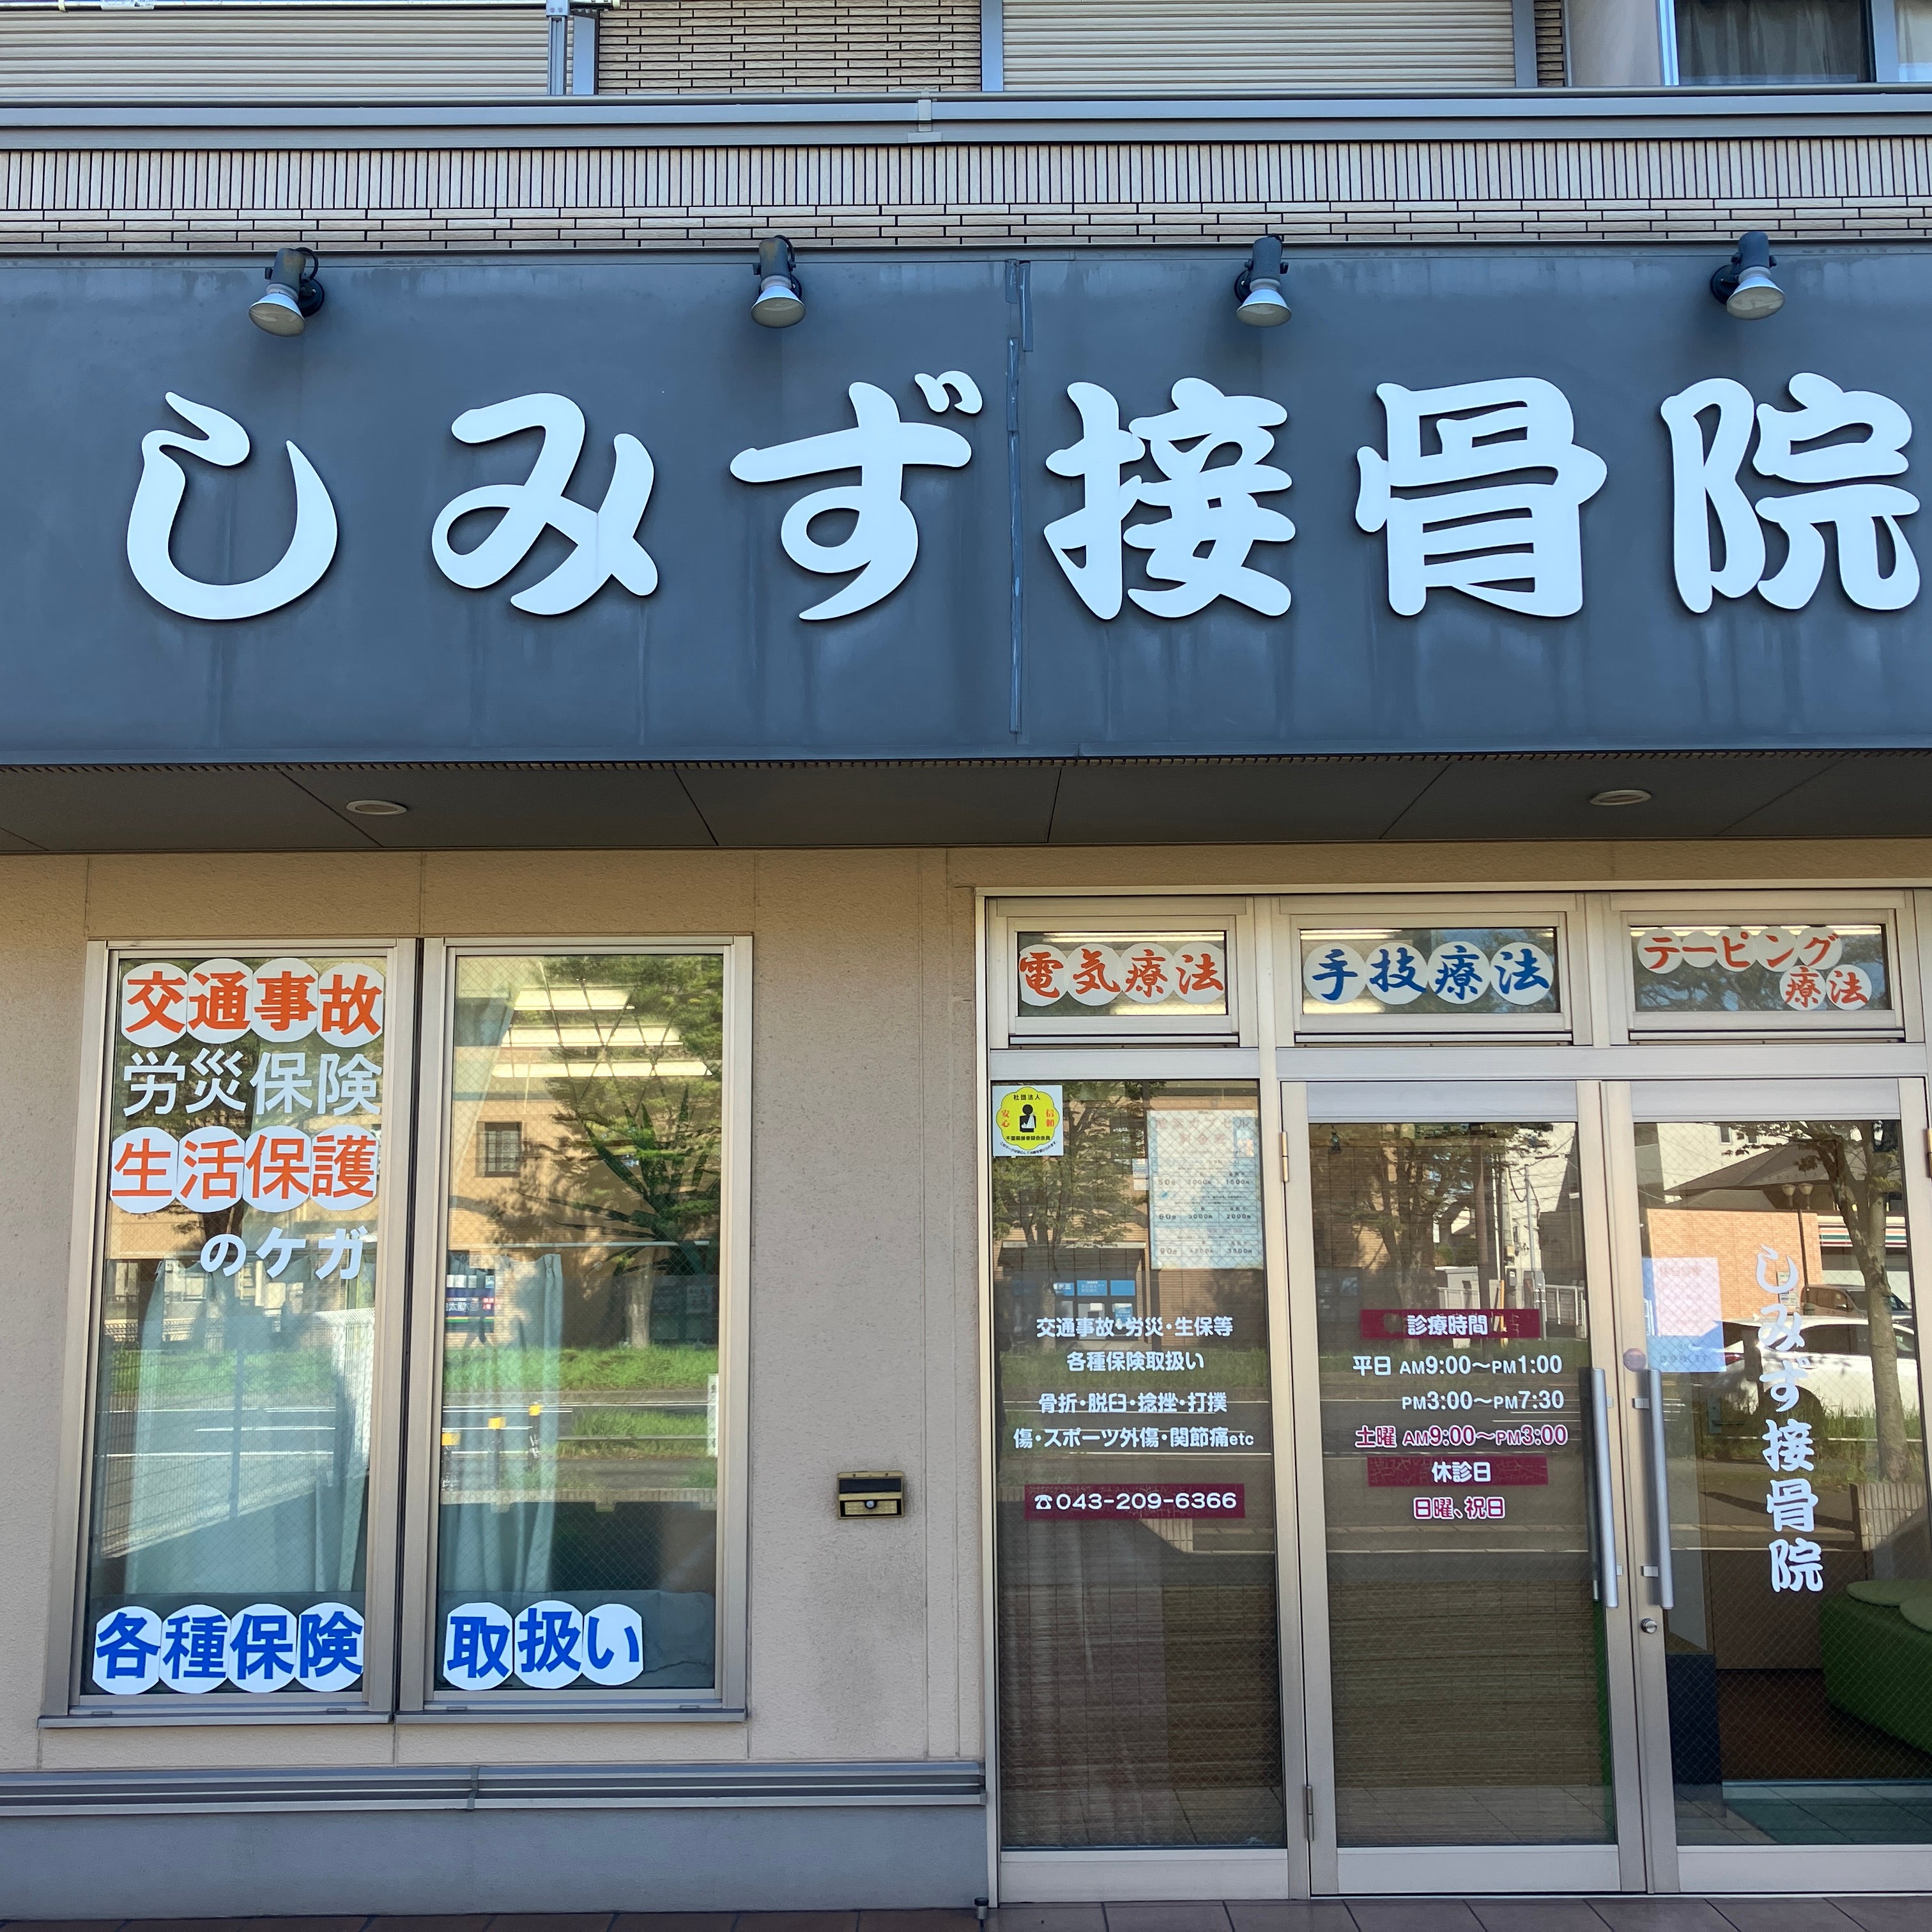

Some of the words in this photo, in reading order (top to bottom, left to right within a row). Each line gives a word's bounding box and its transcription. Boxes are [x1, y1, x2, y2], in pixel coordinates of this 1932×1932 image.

[127, 371, 1920, 620] しみず接骨院
[1644, 931, 1839, 970] テーピング
[1019, 948, 1224, 998] 電気療法
[1312, 946, 1550, 1000] 手技療法
[1785, 967, 1868, 1008] 療法
[126, 970, 383, 1036] 交通事故
[123, 1047, 383, 1117] 労災保険
[111, 1134, 376, 1200] 生活保護
[200, 1225, 368, 1280] のケガ
[1036, 1316, 1234, 1338] 交通事故・労災・生保等
[1406, 1314, 1489, 1336] 診療時間
[1066, 1351, 1205, 1372] 各種保険取扱い
[1352, 1355, 1392, 1376] 平日
[1038, 1392, 1227, 1414] 骨折・脱臼・捻挫・打撲
[1755, 1245, 1823, 1593] しみず接骨院
[1354, 1425, 1397, 1448] 土曜
[1431, 1461, 1491, 1483] 休診日
[1055, 1492, 1238, 1510] 043-209-6366
[1413, 1496, 1506, 1520] 日曜、祝日
[95, 1611, 364, 1680] 各種保険
[447, 1607, 640, 1678] 取扱い
